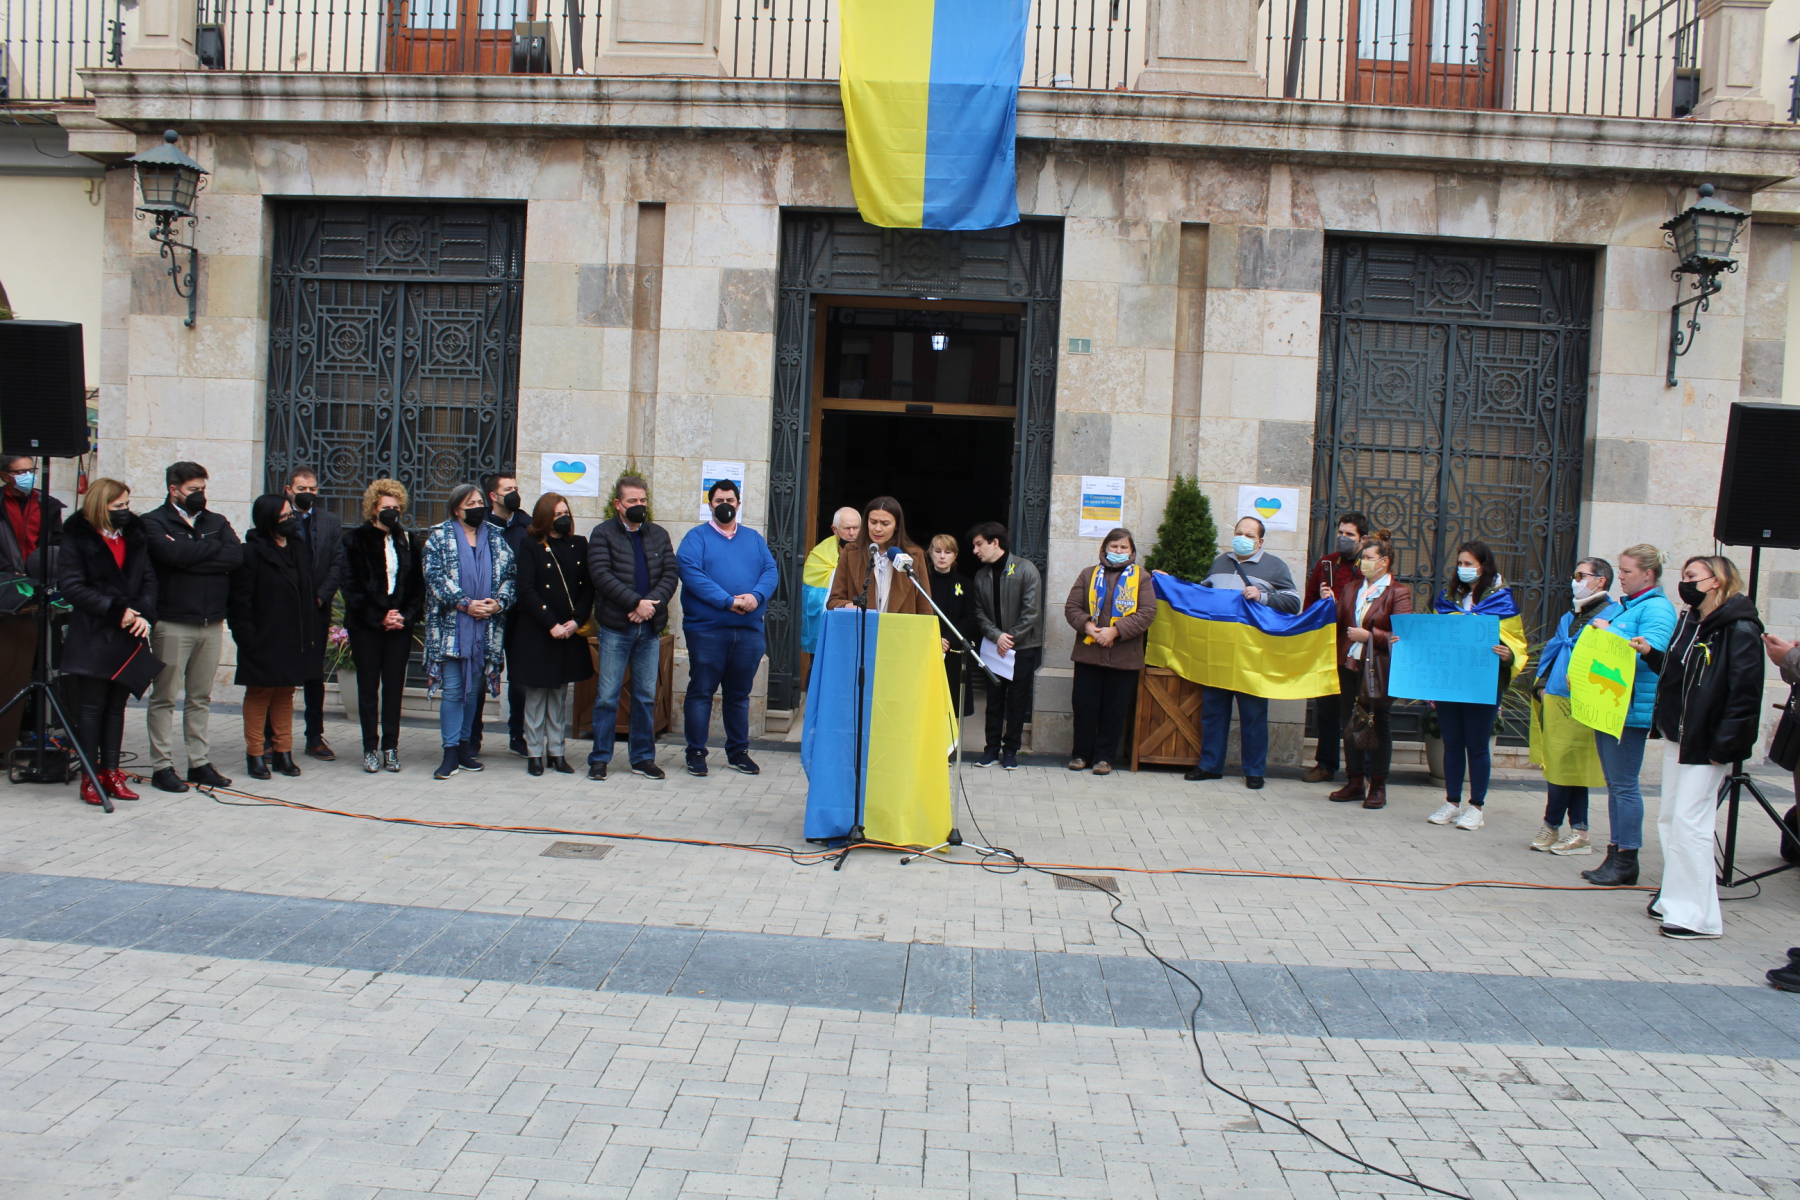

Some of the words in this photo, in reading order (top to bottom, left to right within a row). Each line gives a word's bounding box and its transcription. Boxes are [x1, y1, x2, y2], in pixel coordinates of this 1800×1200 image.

[1077, 339, 1083, 352] 1
[1398, 619, 1460, 642] VETE
[1474, 621, 1498, 644] DE
[1392, 643, 1490, 667] NUESTRA
